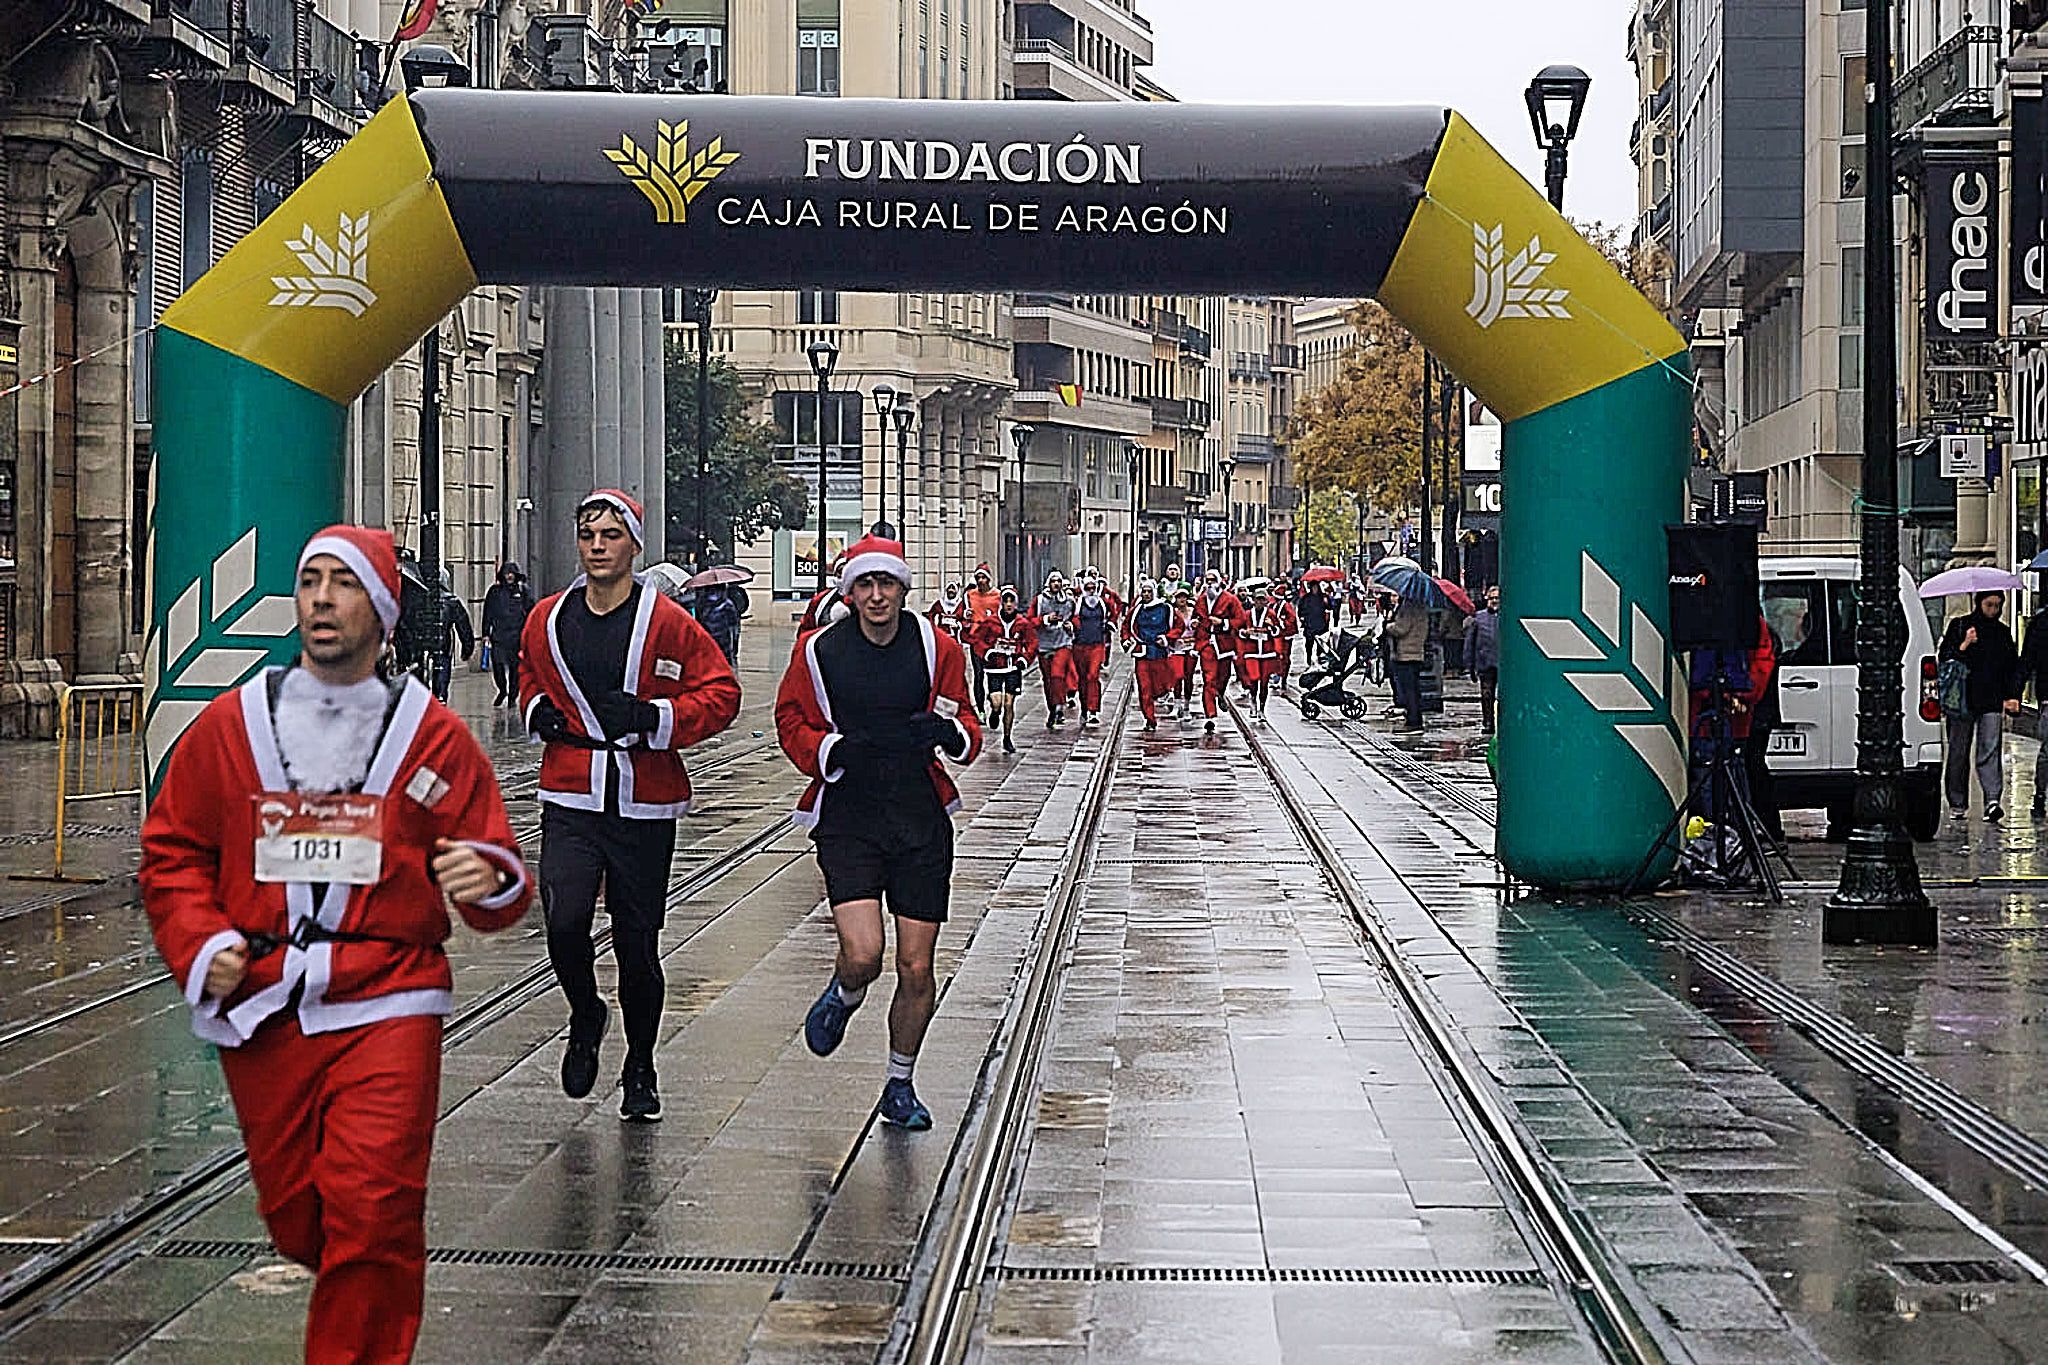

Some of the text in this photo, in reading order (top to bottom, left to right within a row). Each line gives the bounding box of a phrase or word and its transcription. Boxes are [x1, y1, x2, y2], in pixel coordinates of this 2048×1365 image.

[804, 133, 1143, 184] FUNDACIÓN
[716, 198, 1228, 234] CAJA RURAL DE ARAGÓN
[1937, 172, 1988, 333] fnac
[1773, 736, 1801, 750] JTW
[292, 840, 342, 860] 1031
